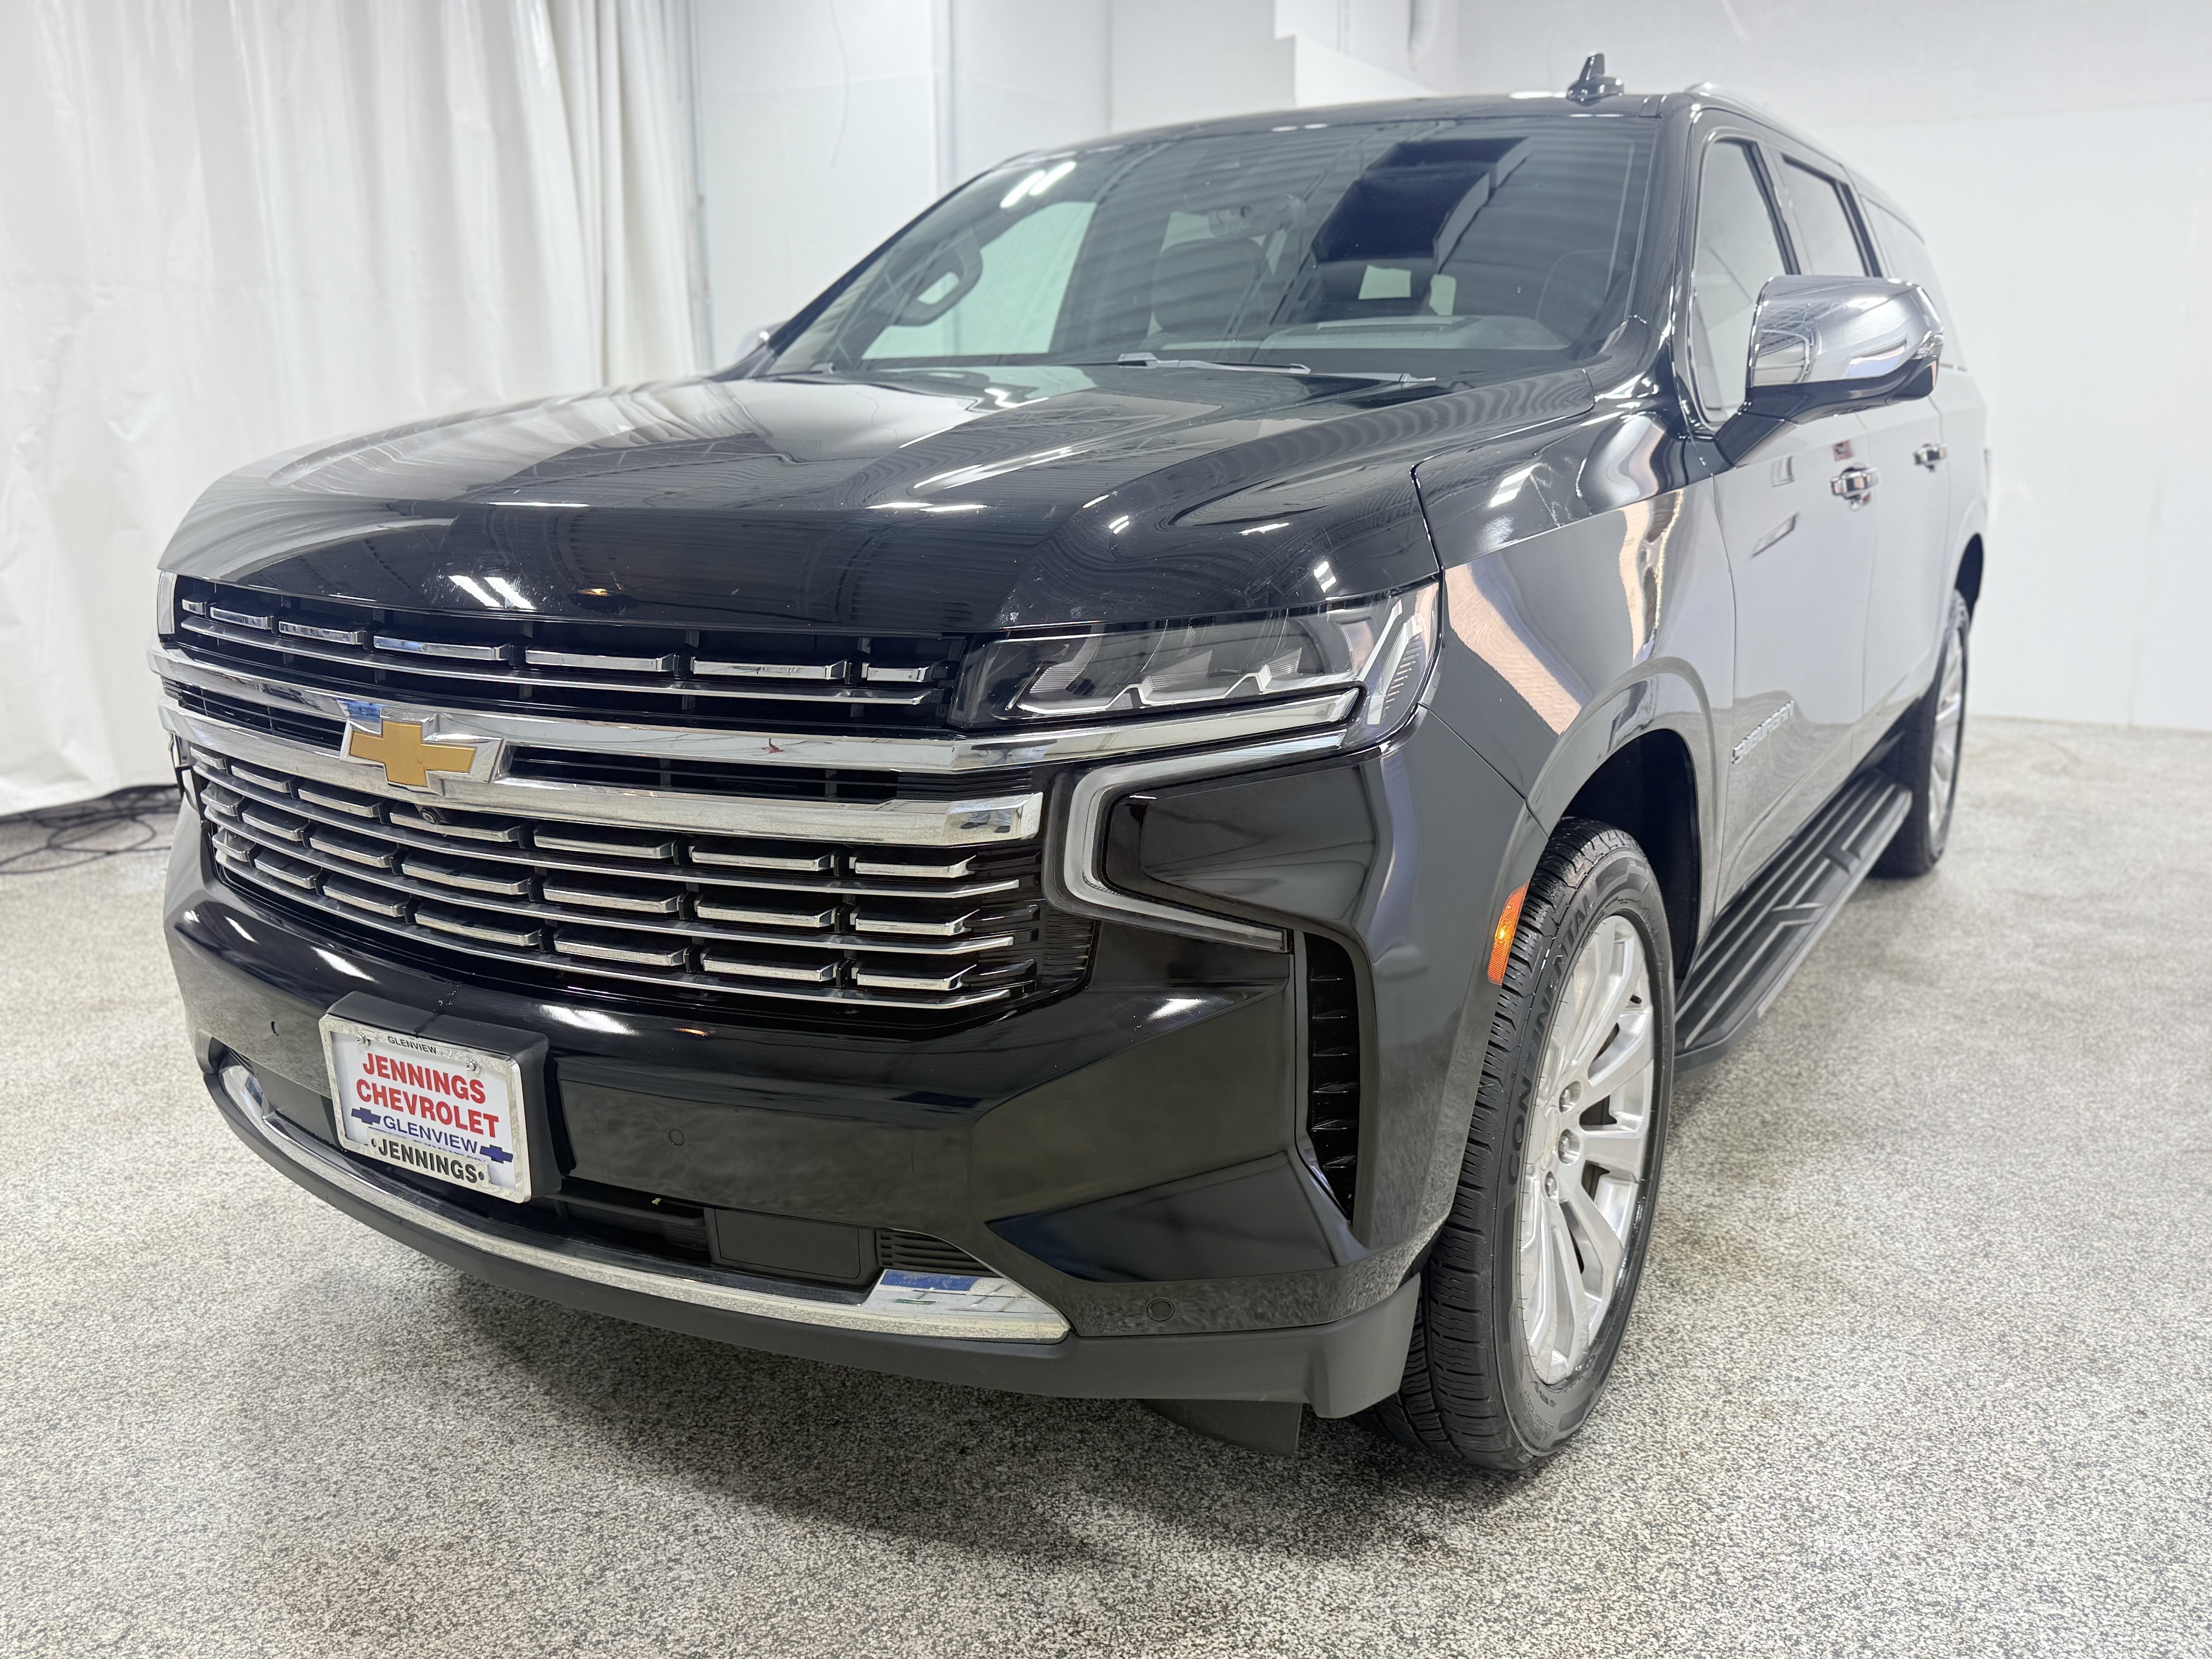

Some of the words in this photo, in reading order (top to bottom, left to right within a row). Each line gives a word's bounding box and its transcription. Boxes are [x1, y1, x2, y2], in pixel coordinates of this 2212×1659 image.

[388, 1036, 437, 1054] GLENVIEW
[1508, 894, 1595, 1185] CONTINENTAL
[362, 1053, 486, 1104] JENNINGS
[356, 1079, 499, 1138] CHEVROLET
[383, 1115, 478, 1154] GLENVIEW
[378, 1138, 478, 1183] JENNINGS
